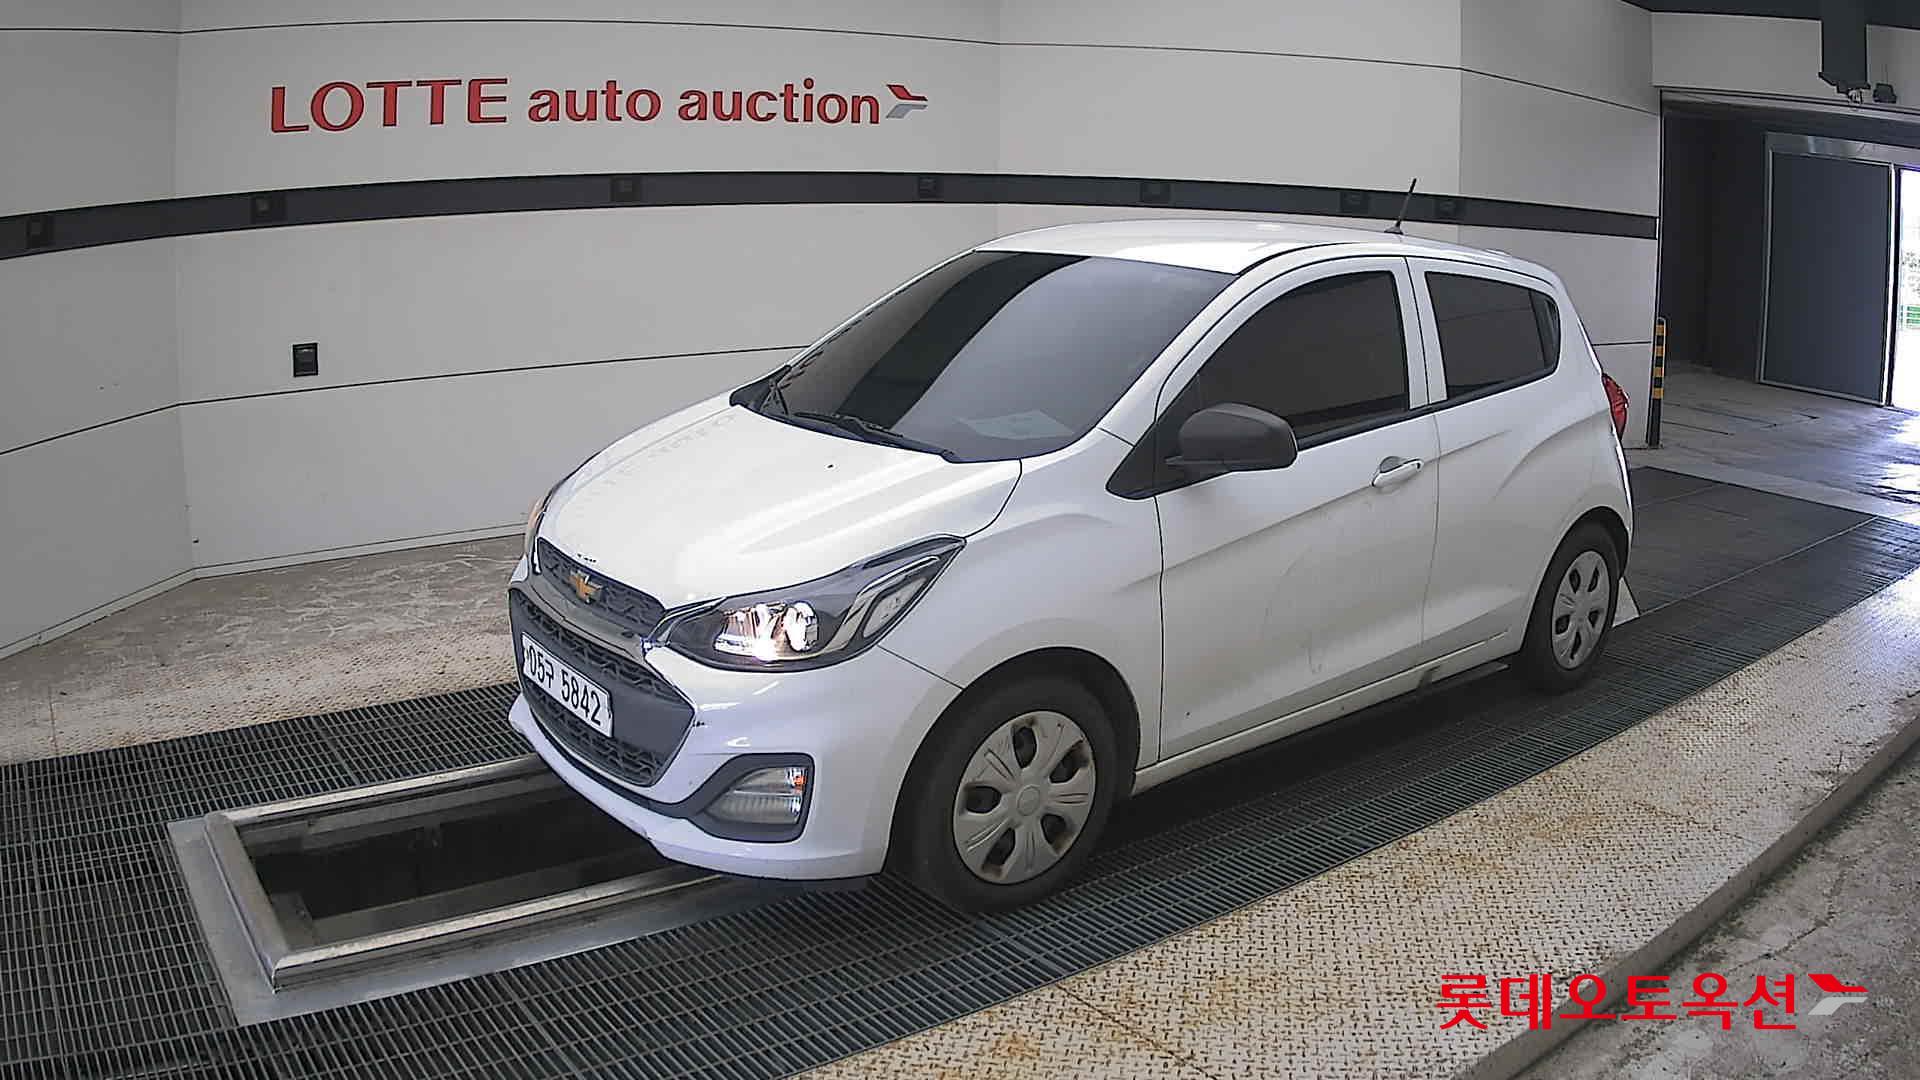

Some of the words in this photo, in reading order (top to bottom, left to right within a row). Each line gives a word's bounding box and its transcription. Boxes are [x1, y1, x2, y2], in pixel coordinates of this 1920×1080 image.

[271, 78, 508, 133] LOTTE
[527, 80, 661, 122] auto
[678, 78, 880, 124] auction
[561, 669, 601, 726] 5842
